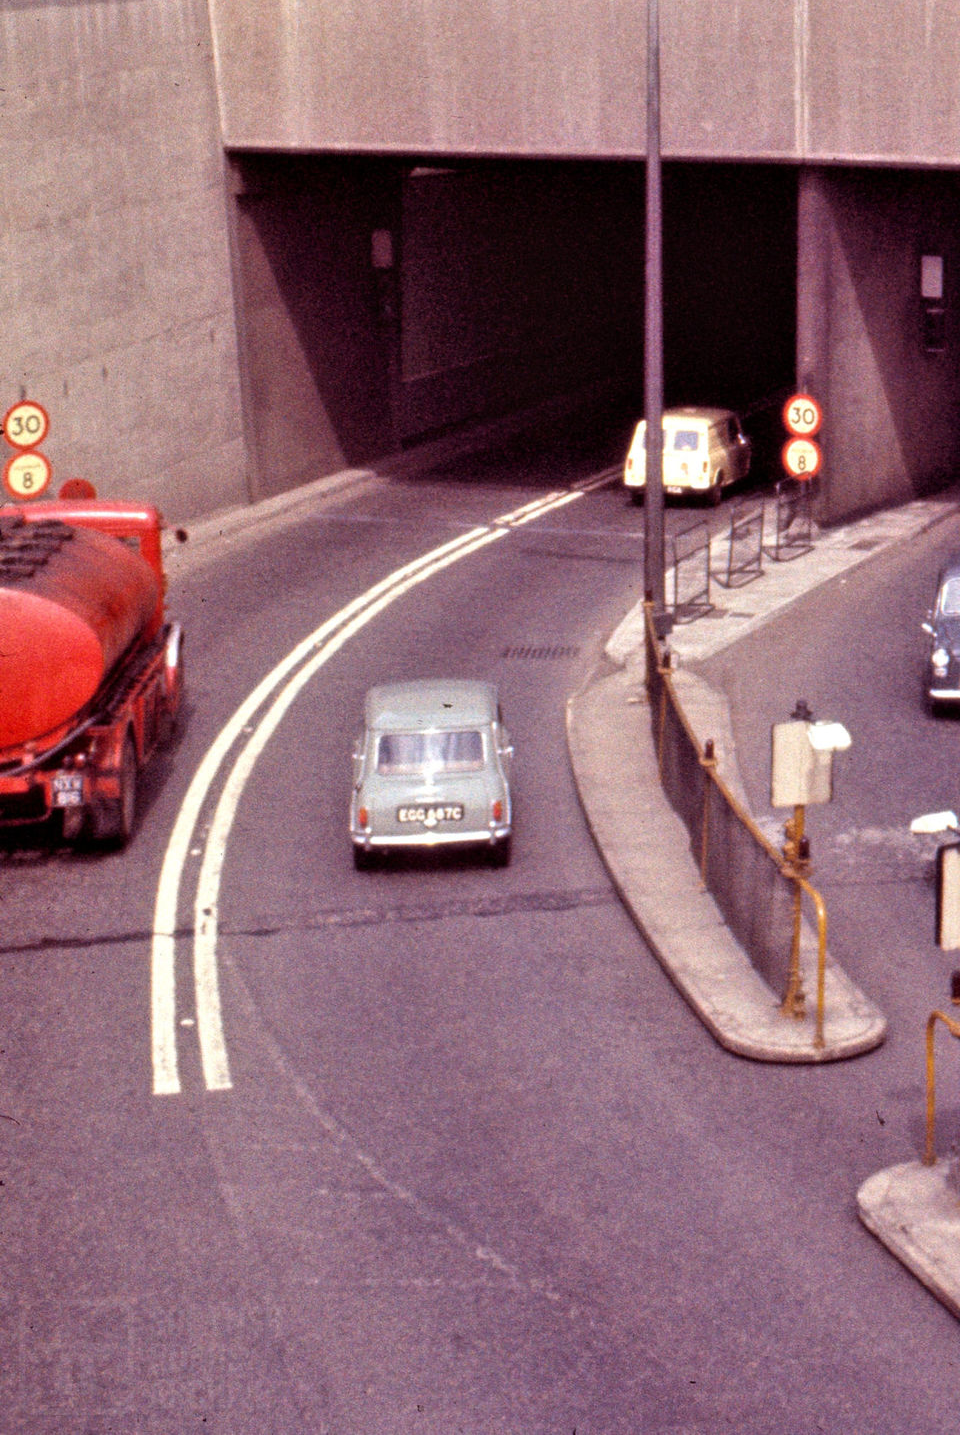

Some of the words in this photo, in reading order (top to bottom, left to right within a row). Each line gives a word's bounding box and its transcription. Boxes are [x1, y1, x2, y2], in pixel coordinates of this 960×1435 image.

[791, 406, 815, 425] 30
[12, 415, 40, 436] 30
[797, 454, 807, 471] 8
[22, 471, 34, 489] 8
